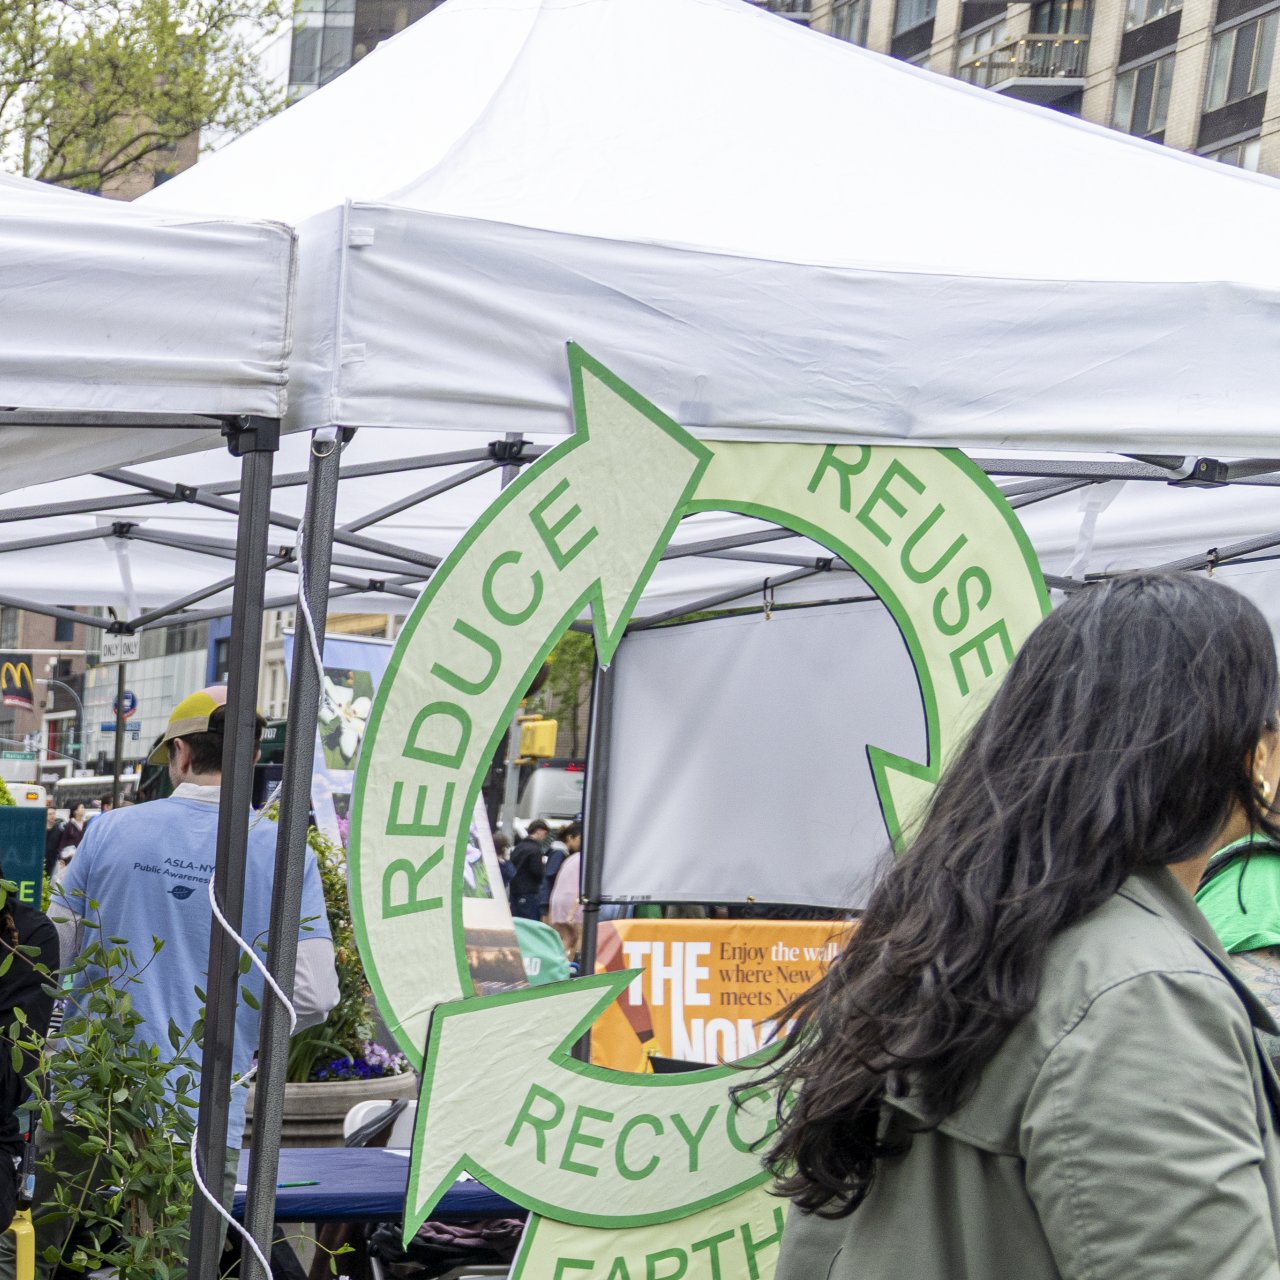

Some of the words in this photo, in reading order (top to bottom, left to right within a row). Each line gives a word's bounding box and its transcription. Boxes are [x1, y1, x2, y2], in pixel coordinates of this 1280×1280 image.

[807, 444, 1015, 696] REUSE
[103, 643, 120, 658] ONLY
[122, 641, 139, 655] ONLY
[382, 478, 600, 919] REDUCE
[133, 862, 162, 874] Public
[162, 868, 210, 884] Awarenes
[163, 857, 216, 873] ASLA-NY
[719, 942, 770, 966] Enjoy
[771, 941, 800, 962] the
[623, 941, 711, 1006] THE
[719, 965, 773, 983] where
[775, 966, 811, 983] New
[720, 990, 772, 1006] meets
[504, 1082, 780, 1181] RECYC
